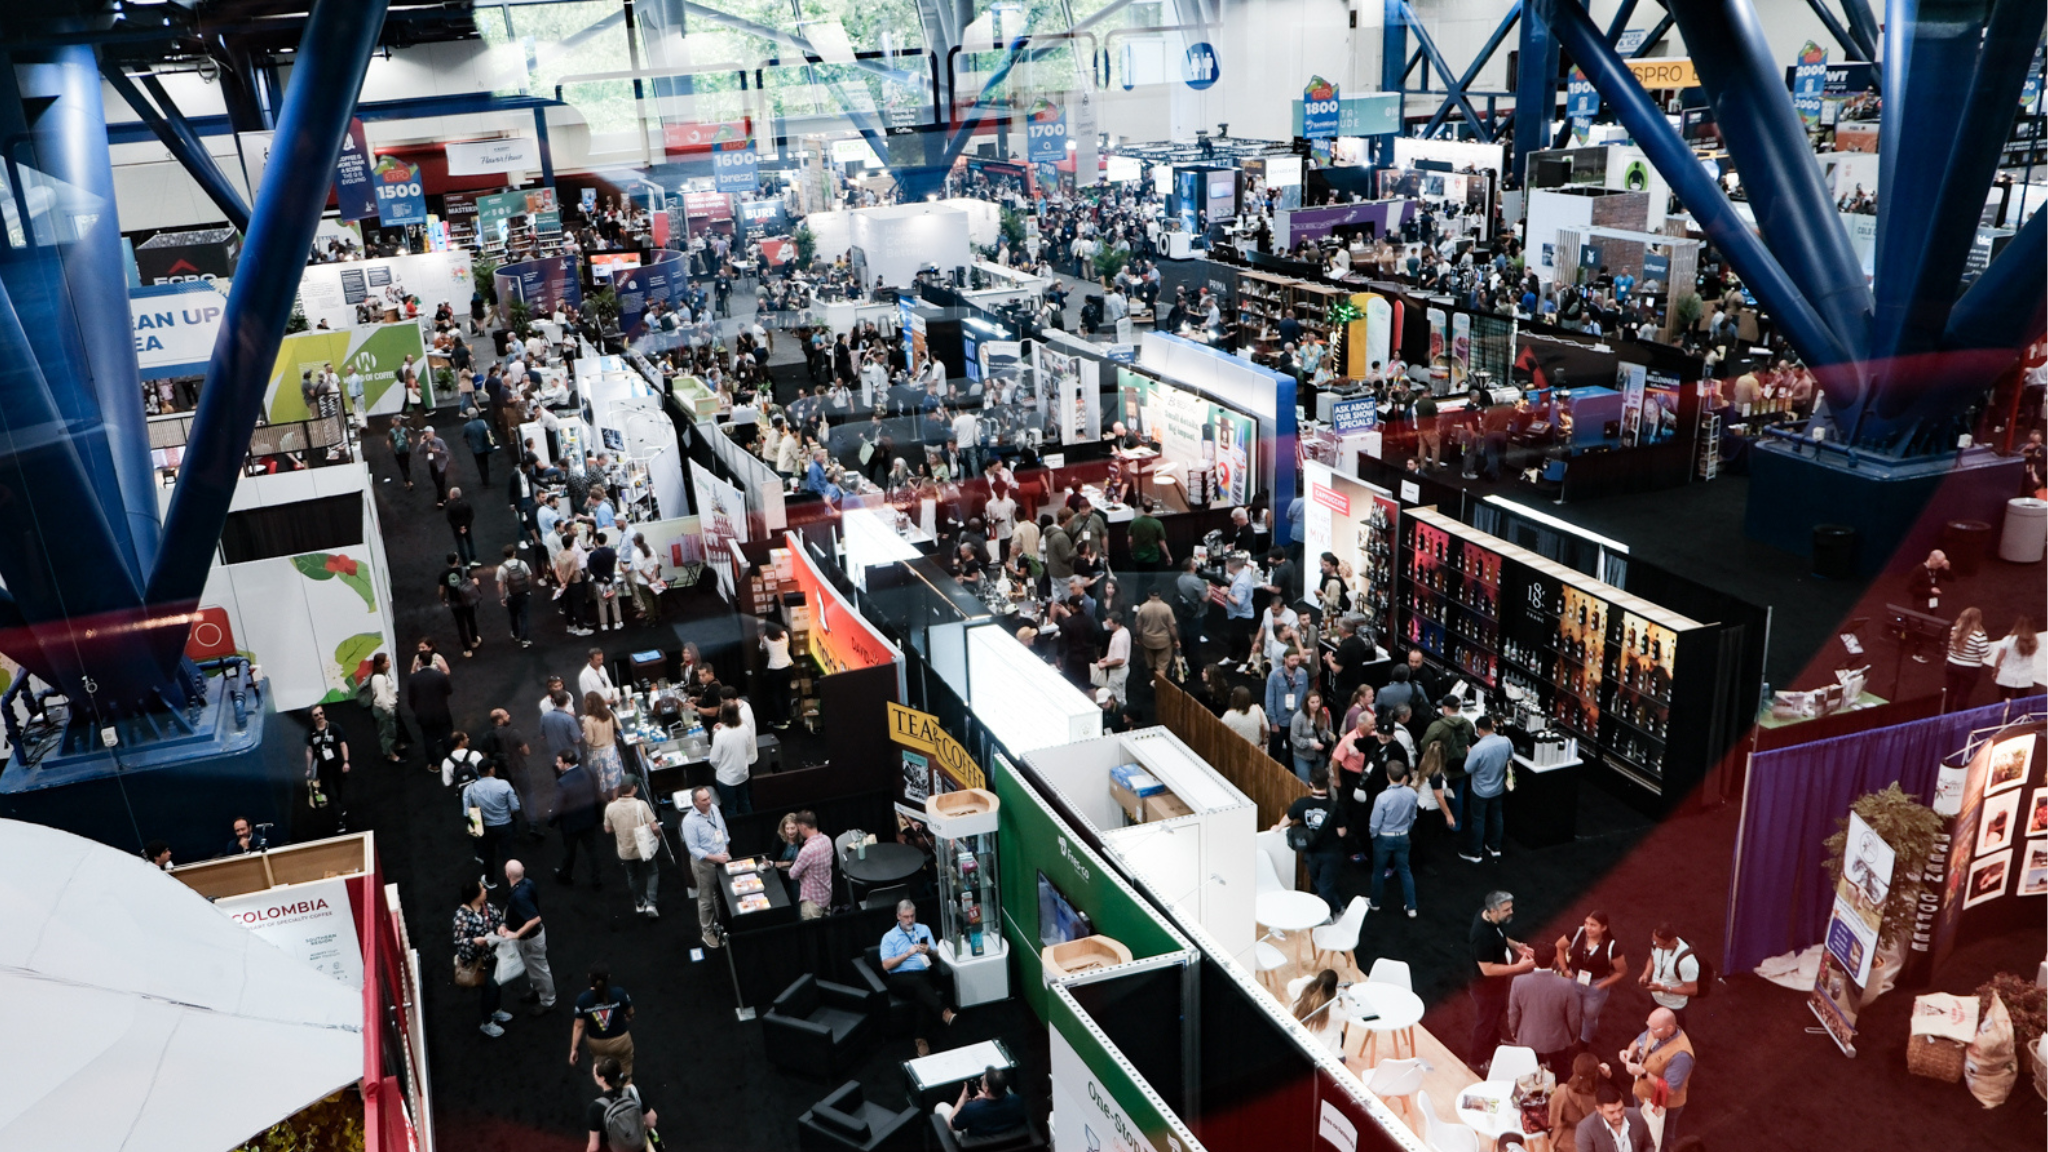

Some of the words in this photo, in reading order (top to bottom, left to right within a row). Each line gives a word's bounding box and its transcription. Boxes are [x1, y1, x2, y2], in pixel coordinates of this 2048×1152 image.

[1631, 65, 1682, 82] SPRO
[1796, 65, 1826, 77] 2000
[1825, 70, 1849, 81] WT
[1313, 90, 1332, 98] EXPO
[1305, 101, 1338, 115] 1800
[1795, 99, 1820, 110] 2000
[1029, 124, 1065, 138] 1700
[723, 141, 746, 150] EXPO
[1314, 139, 1329, 150] 1800
[715, 152, 755, 167] 1600
[1041, 163, 1055, 175] 1700
[386, 171, 409, 181] EXPO
[376, 183, 421, 199] 1500
[745, 207, 777, 219] BURR
[183, 307, 220, 325] UP
[374, 371, 395, 381] COFFEE
[1335, 405, 1349, 414] ASK
[1351, 401, 1374, 411] ABOUT
[1336, 413, 1352, 422] OUR
[1353, 409, 1375, 419] SHOW
[1339, 418, 1373, 429] SPECIALS!
[893, 708, 933, 742] TEA
[943, 738, 984, 788] COFFEE
[232, 898, 329, 925] COLOMBIA
[277, 915, 308, 926] SPECIALTY
[309, 910, 333, 920] COFFEE
